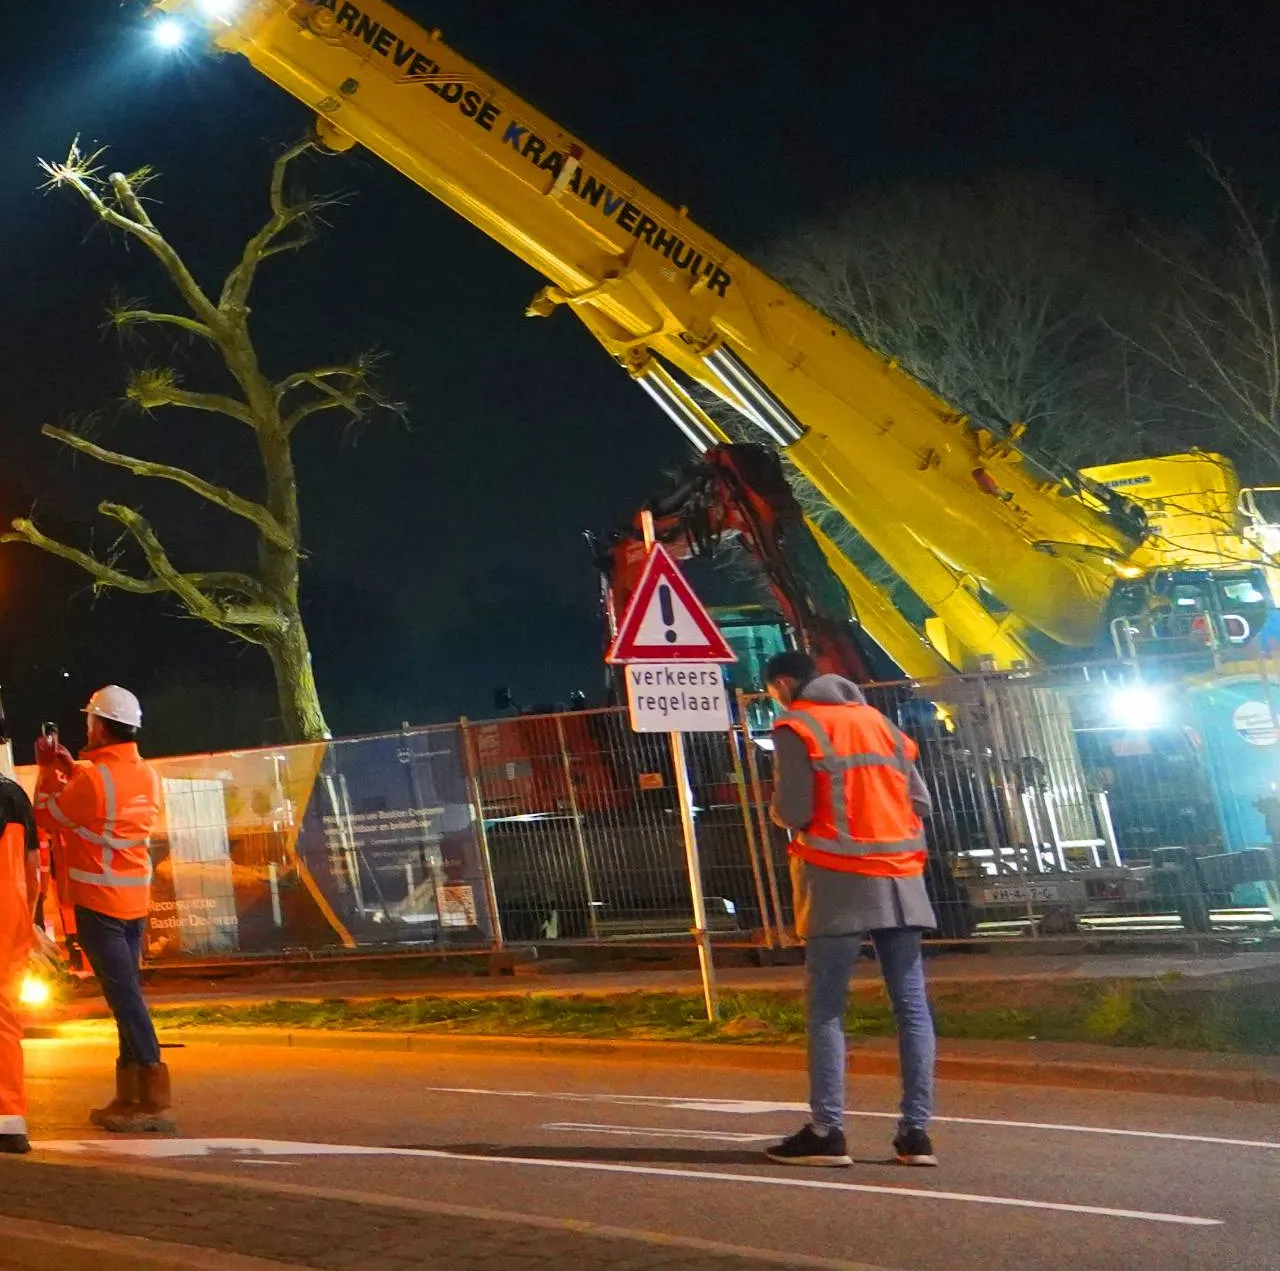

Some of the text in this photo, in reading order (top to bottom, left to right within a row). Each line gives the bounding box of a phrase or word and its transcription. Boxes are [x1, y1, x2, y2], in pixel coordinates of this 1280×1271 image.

[501, 120, 732, 299] KRAANVERHUUR
[632, 667, 719, 686] verkeers
[637, 692, 720, 717] regelaar
